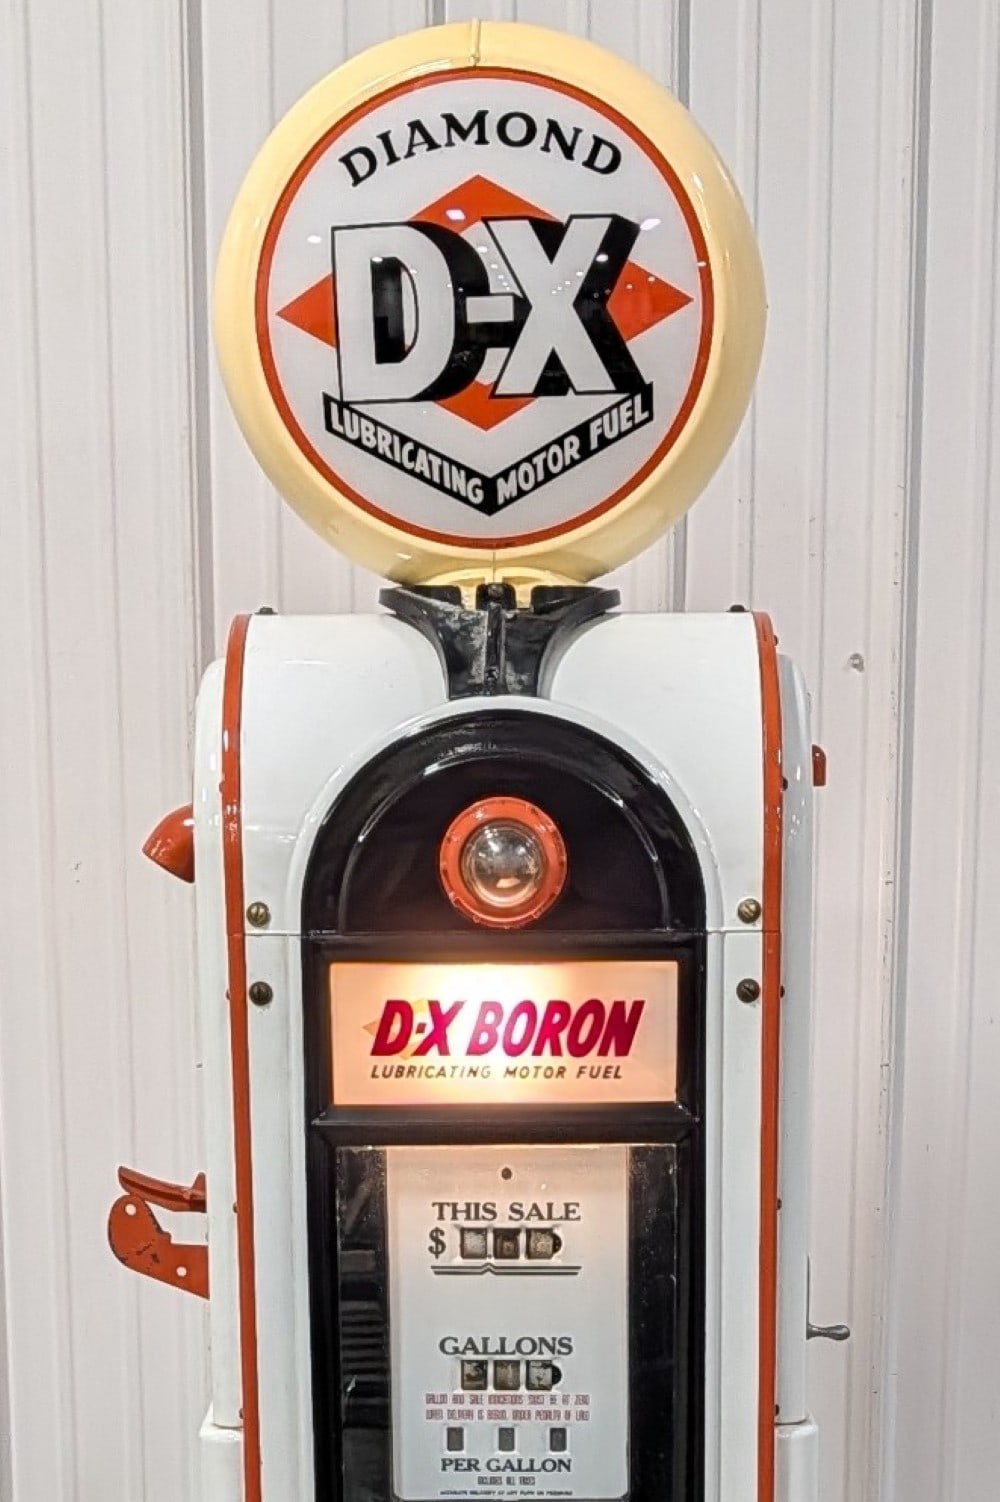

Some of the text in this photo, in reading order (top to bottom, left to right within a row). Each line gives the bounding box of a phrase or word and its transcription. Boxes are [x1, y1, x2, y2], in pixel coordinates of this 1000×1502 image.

[337, 109, 622, 188] DIAMOND
[331, 213, 650, 403] D-X
[330, 400, 651, 506] LUBRICATING MOTOR FUEL
[466, 998, 645, 1058] BORON
[371, 1065, 623, 1079] LUBRICATING MOTOR FUEL
[432, 1202, 581, 1221] THIS SALE
[428, 1227, 446, 1259] $
[438, 1336, 573, 1355] GALLONS
[441, 1458, 572, 1473] PER GALLON
